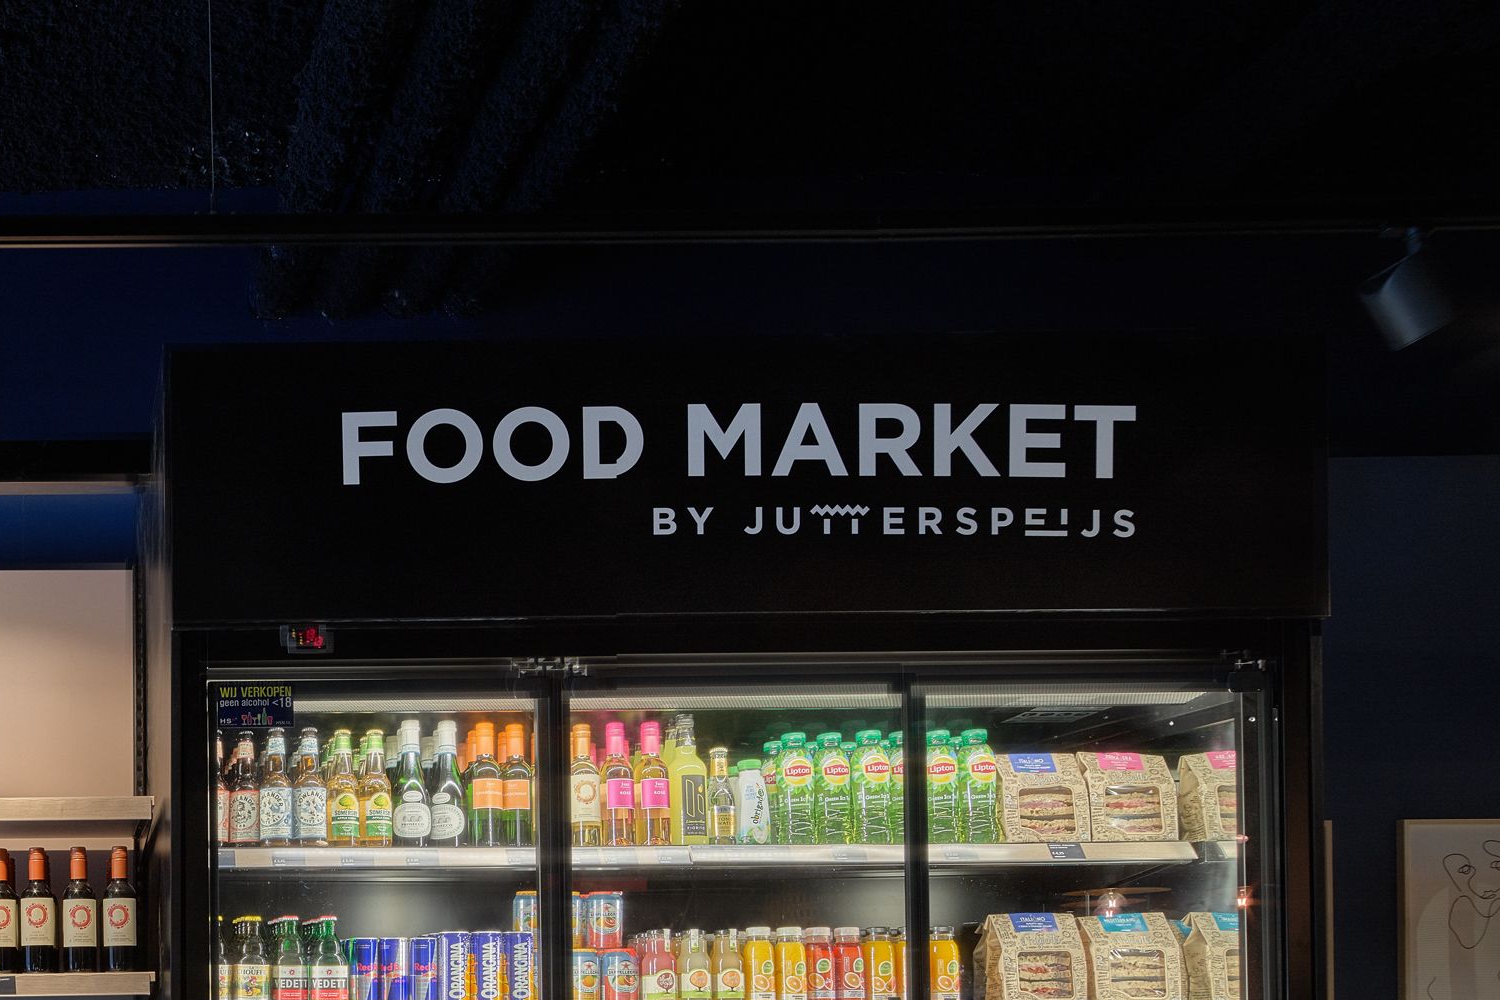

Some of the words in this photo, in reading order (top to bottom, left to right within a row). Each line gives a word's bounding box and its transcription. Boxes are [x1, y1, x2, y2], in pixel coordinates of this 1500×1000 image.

[341, 406, 644, 485] FOOD
[687, 403, 1136, 479] MARKET
[652, 507, 714, 536] BY
[220, 687, 237, 697] WIJ
[241, 686, 292, 697] VERKOPEN
[220, 700, 239, 708] geen
[241, 699, 269, 707] alcohol
[272, 697, 292, 708] <18
[785, 766, 812, 776] Lipton
[824, 765, 849, 775] Lipton
[866, 764, 890, 774] Lipton
[929, 764, 955, 773] Lipton
[449, 942, 465, 999] ORANGINA
[481, 942, 496, 999] ORANGINA
[513, 942, 529, 999] ORANGINA
[312, 979, 346, 988] VEDETT
